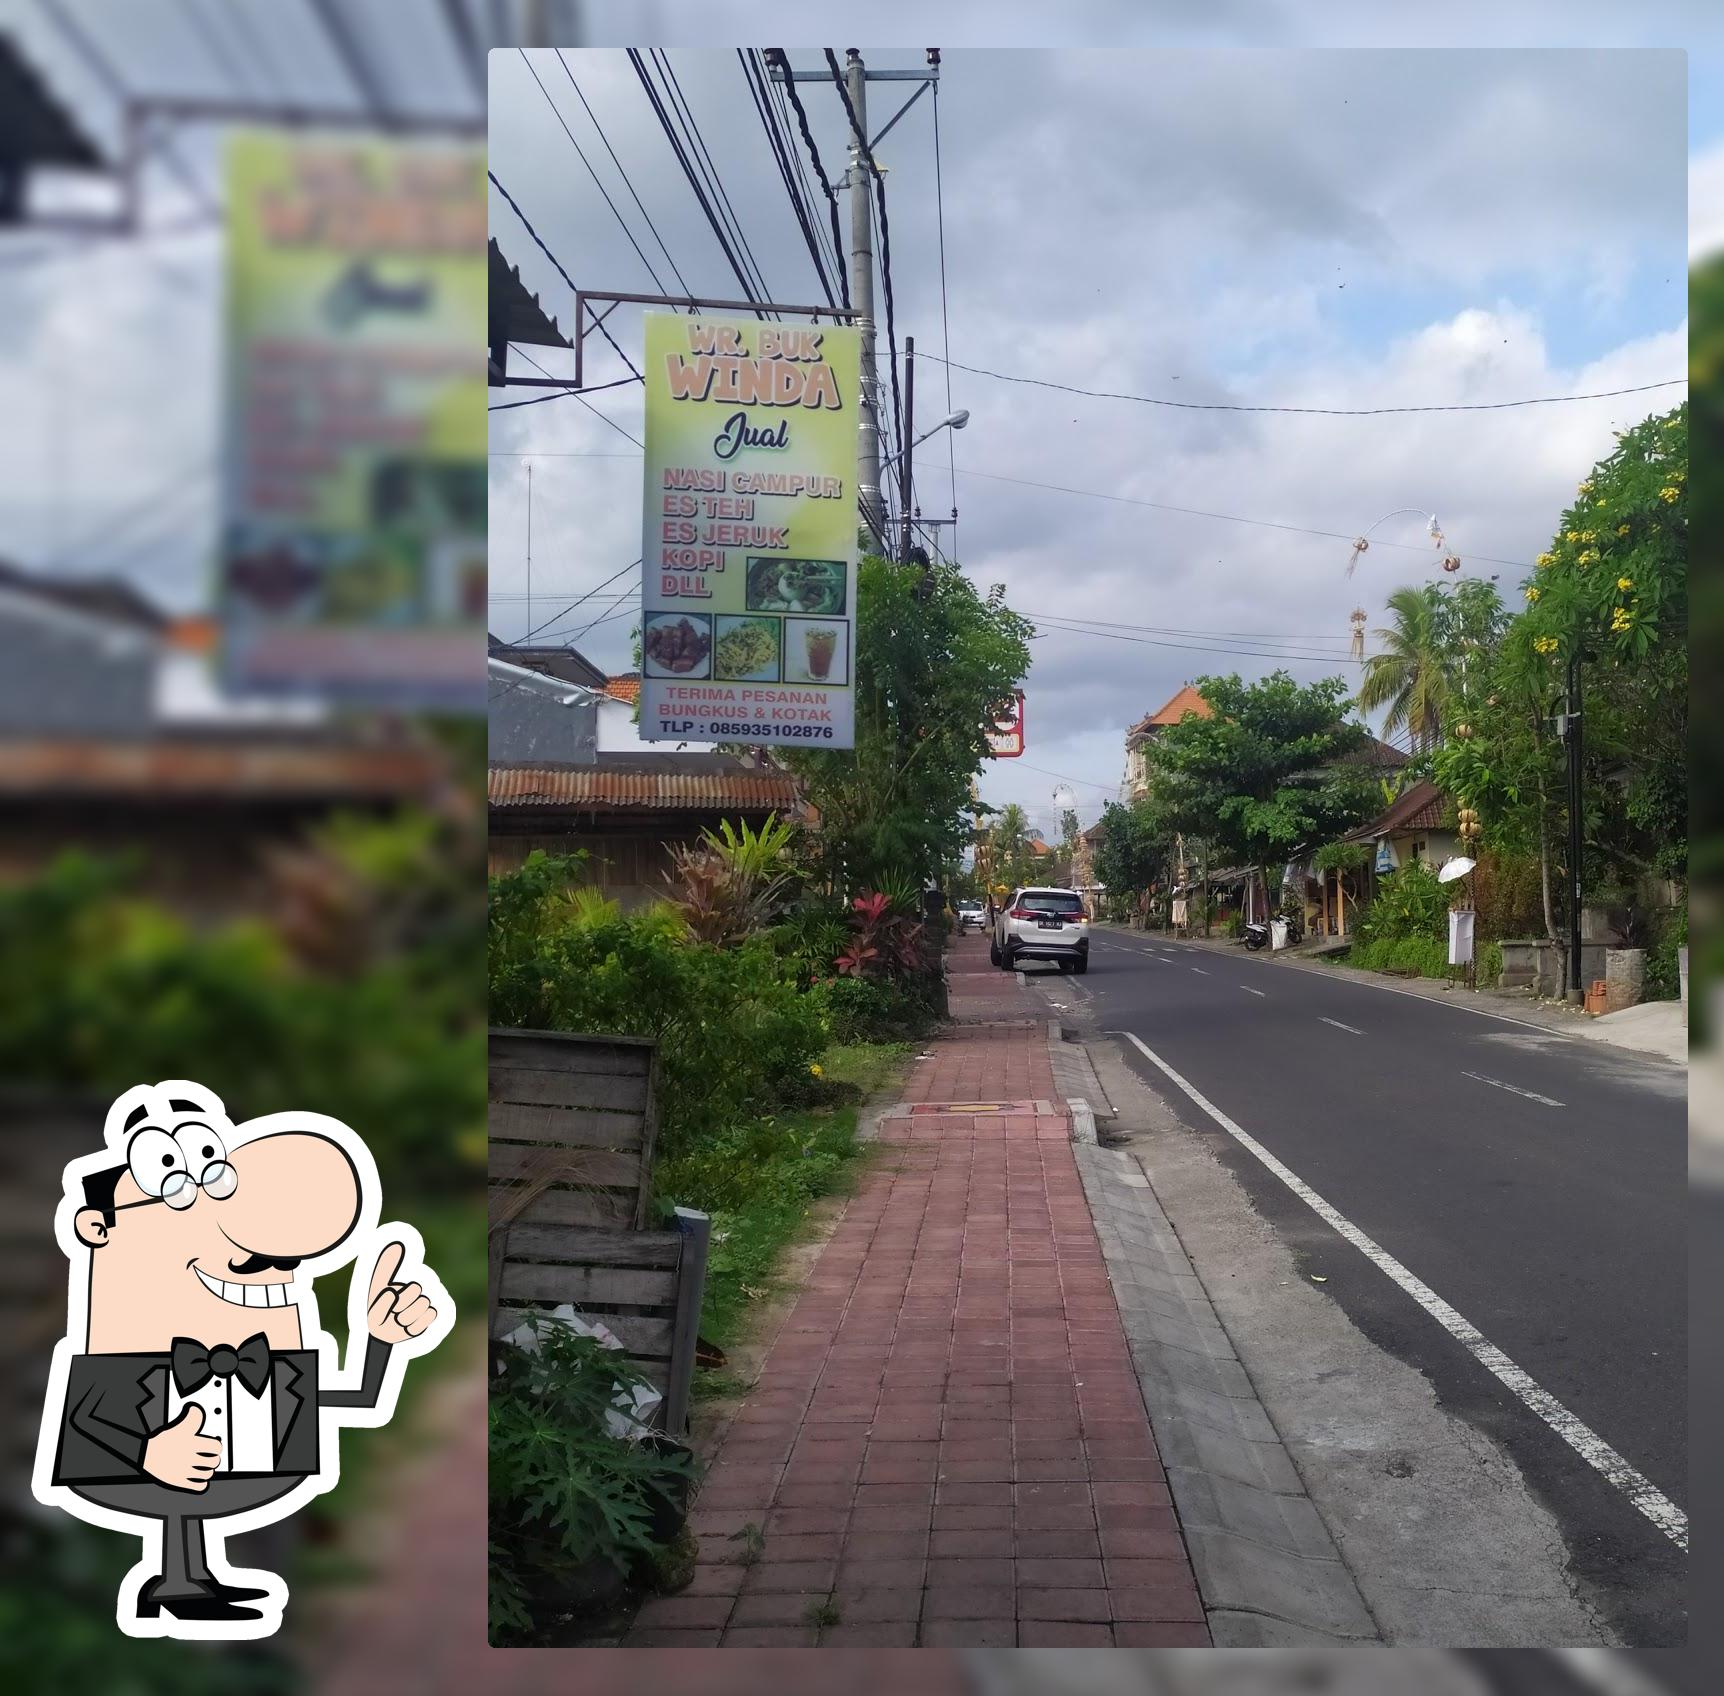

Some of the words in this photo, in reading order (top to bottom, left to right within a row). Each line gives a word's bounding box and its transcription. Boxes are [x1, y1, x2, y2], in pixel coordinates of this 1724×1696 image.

[688, 323, 749, 357] WR.
[759, 329, 824, 363] BUK
[666, 353, 842, 410] WINDA
[714, 411, 788, 460] Jual
[664, 468, 726, 492] NASI
[731, 471, 842, 499] CAMPUR
[663, 494, 698, 517] ES
[702, 496, 754, 520] TEH
[662, 521, 697, 544] ES
[702, 523, 789, 549] JERUK
[661, 548, 725, 571] KOPI
[661, 574, 712, 598] DLL
[666, 687, 736, 701] TERIMA
[742, 690, 827, 704] PESANAN
[659, 703, 748, 719] BUNGKUS
[754, 707, 765, 719] &
[772, 708, 832, 722] KOTAK
[660, 720, 694, 734] TLP
[710, 722, 833, 738] 085935102876
